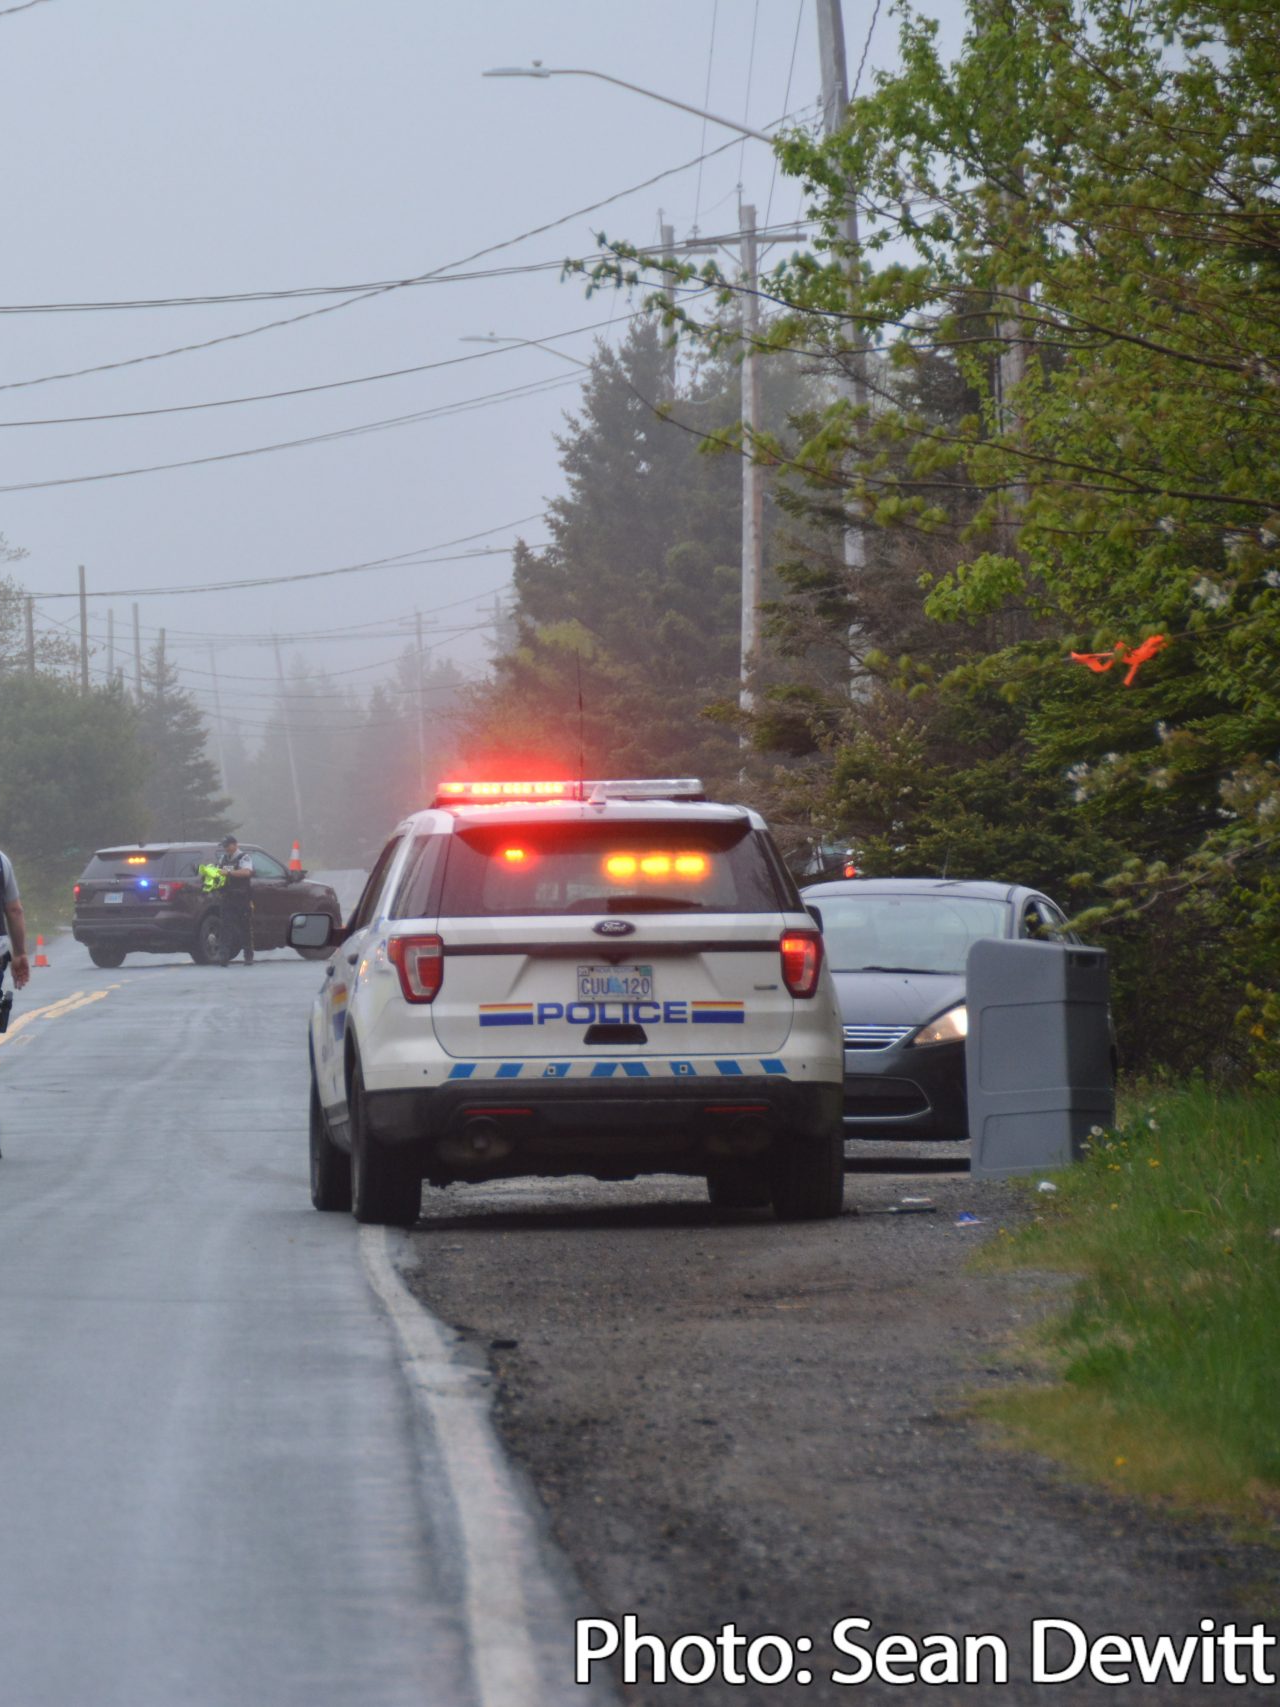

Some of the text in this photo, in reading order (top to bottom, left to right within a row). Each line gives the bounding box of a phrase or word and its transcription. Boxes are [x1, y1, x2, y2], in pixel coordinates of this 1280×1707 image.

[601, 922, 627, 932] Ford
[581, 977, 650, 995] CUU 120
[537, 1001, 688, 1024] POLICE
